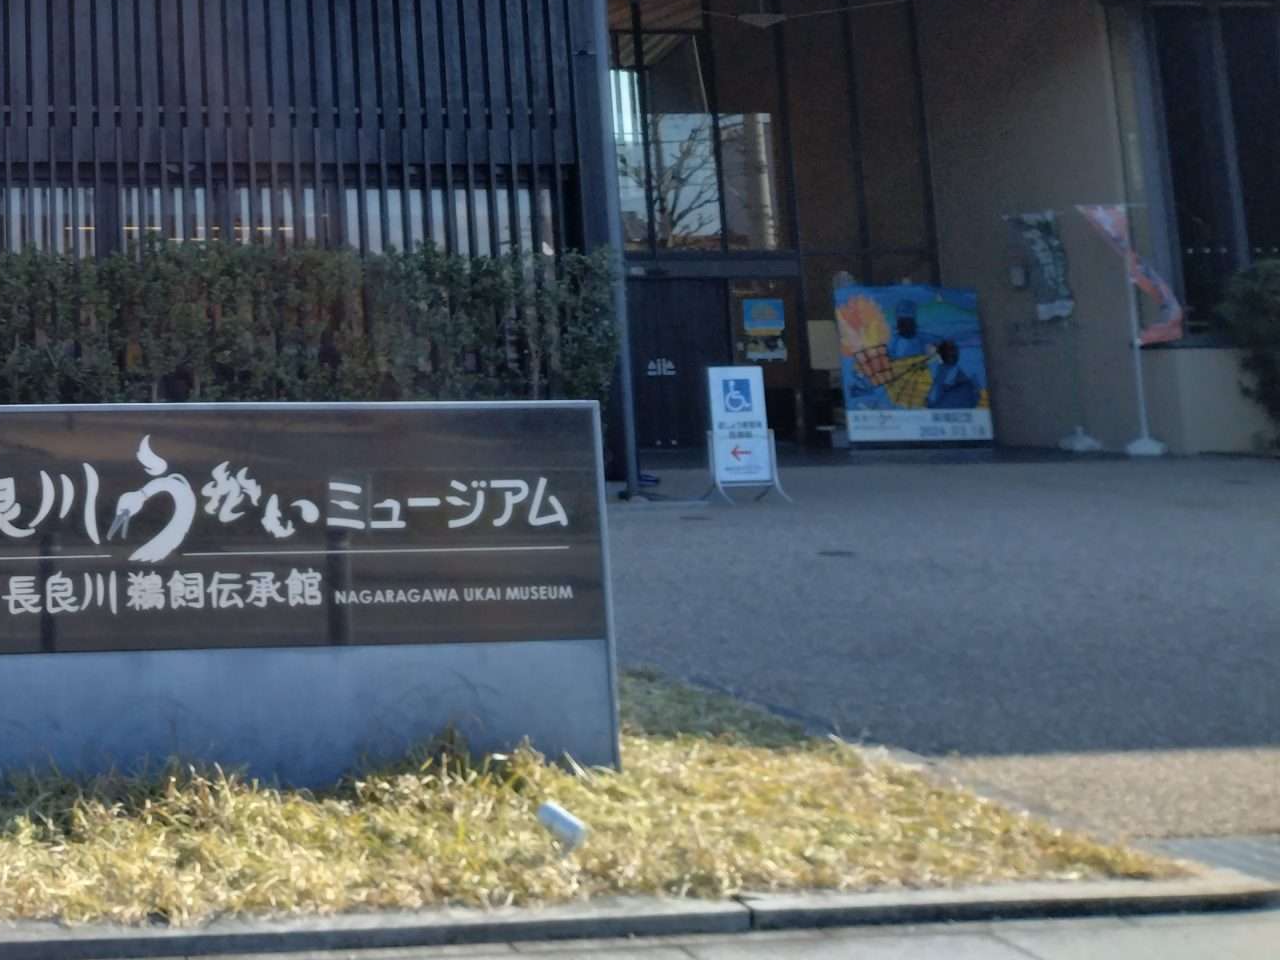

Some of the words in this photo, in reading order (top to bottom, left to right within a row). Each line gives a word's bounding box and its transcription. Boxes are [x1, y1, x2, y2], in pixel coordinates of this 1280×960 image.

[334, 588, 459, 604] NAGARAGAWA
[464, 587, 502, 602] UKAI
[505, 585, 574, 601] MUSEUM
